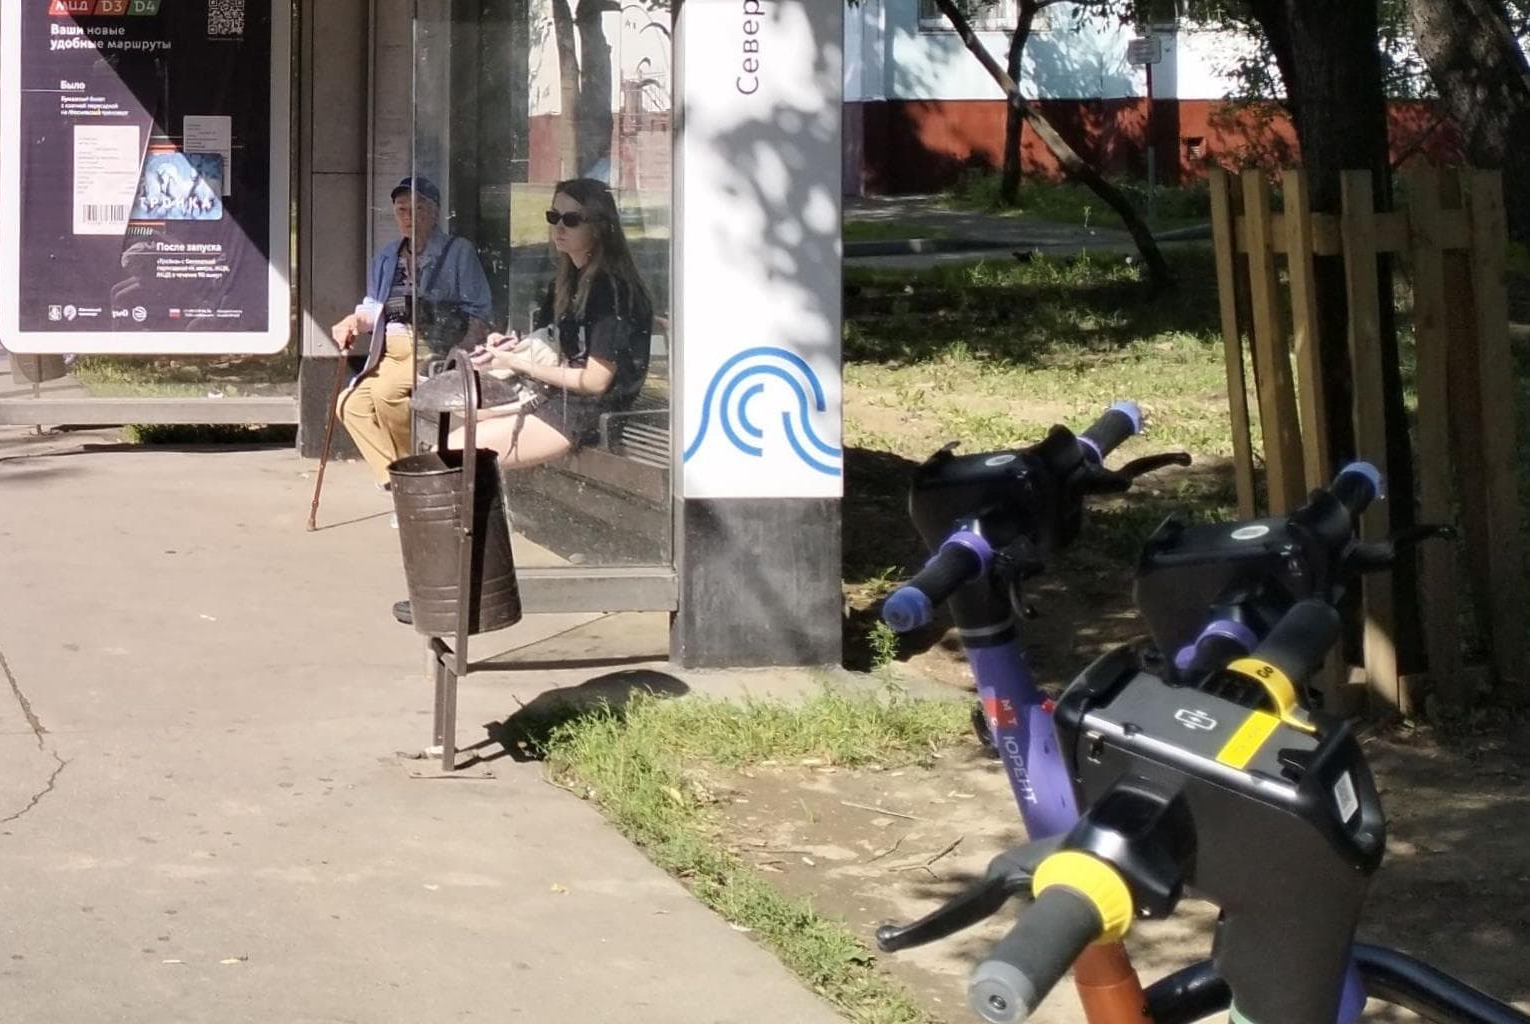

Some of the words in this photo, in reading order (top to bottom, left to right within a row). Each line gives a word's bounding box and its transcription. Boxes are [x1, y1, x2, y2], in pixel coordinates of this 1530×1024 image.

[54, 0, 88, 11] МЦД
[102, 0, 123, 12] D3
[134, 0, 156, 12] D4
[50, 24, 84, 35] Ваши
[86, 26, 125, 35] новые
[50, 37, 104, 50] удобные
[107, 40, 172, 51] маршруты
[60, 80, 86, 89] Было
[156, 242, 185, 251] После
[186, 244, 222, 253] запуска
[1003, 736, 1038, 804] ЮРЕНТ
